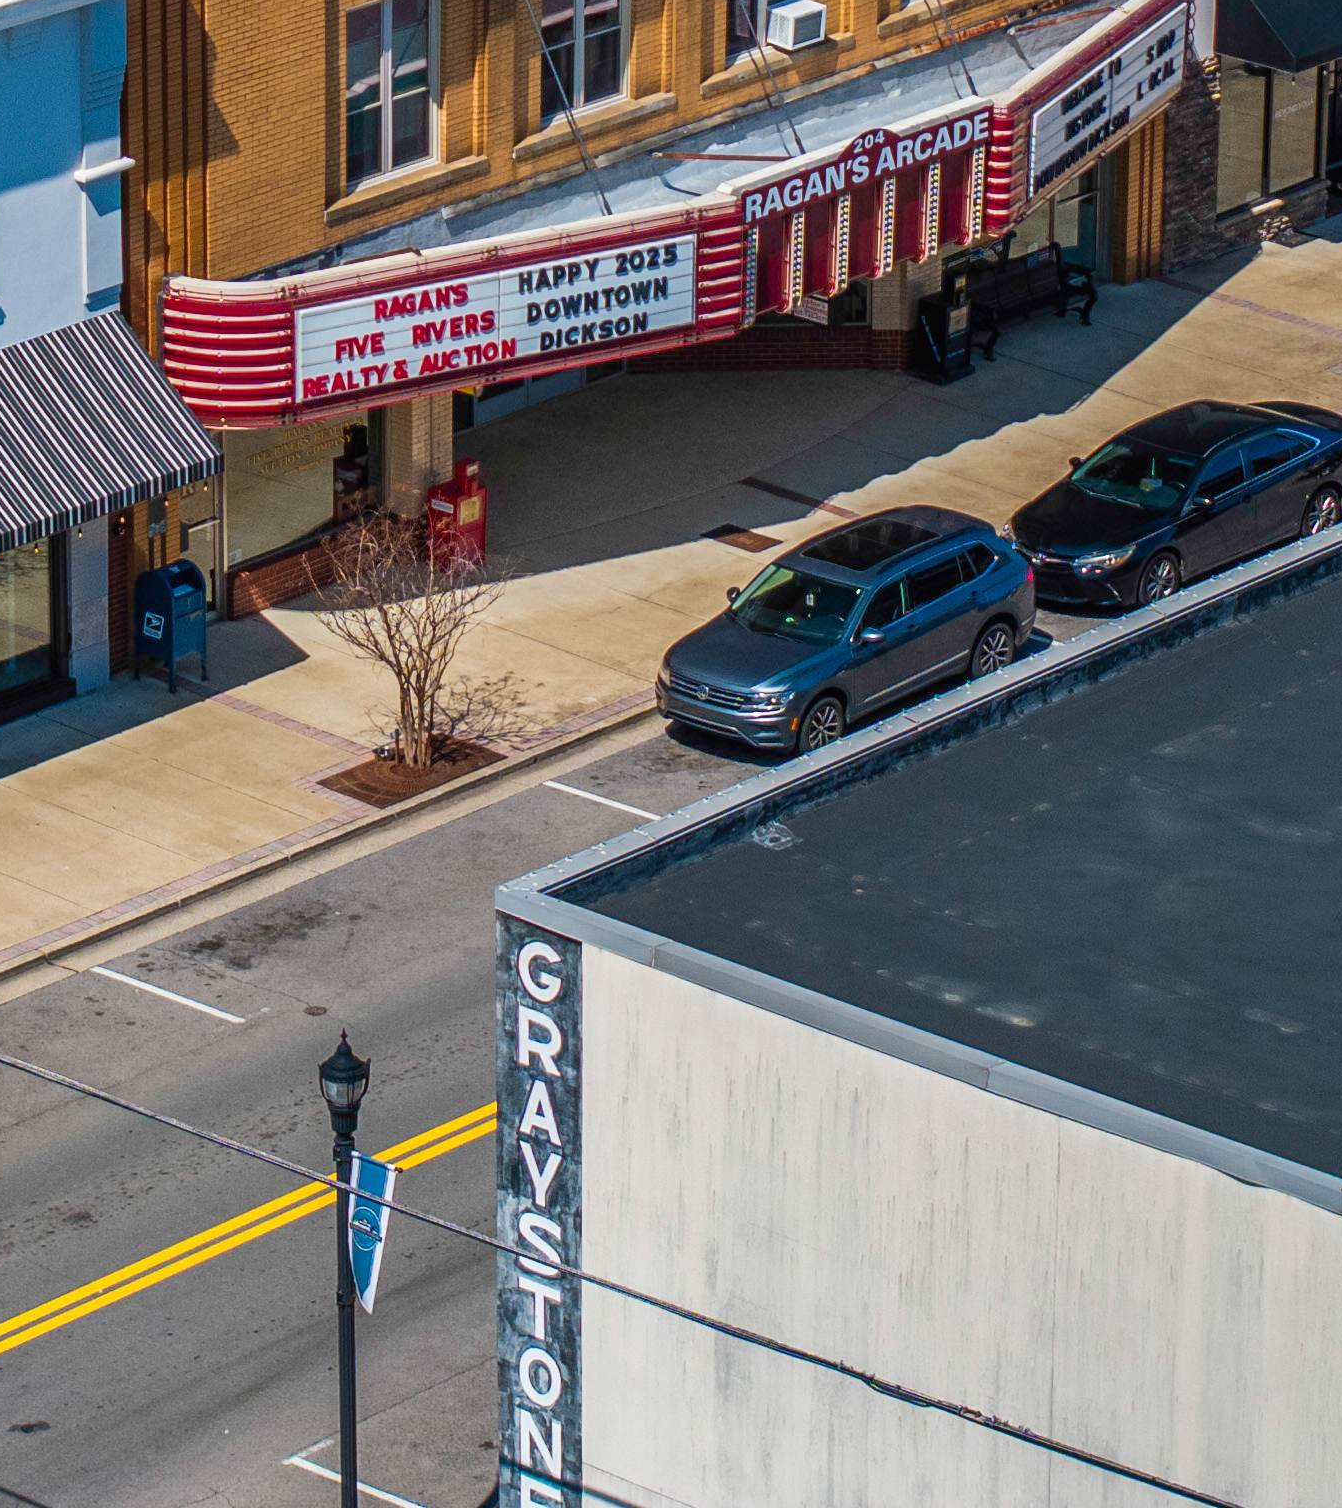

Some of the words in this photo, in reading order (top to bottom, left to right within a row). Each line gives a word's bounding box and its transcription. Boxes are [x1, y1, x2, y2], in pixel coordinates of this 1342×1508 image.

[744, 154, 870, 222] RAGAN'S
[875, 113, 989, 182] ARCADE
[853, 130, 886, 154] 204
[518, 257, 600, 295] HAPPY
[615, 243, 679, 274] 2025
[374, 283, 469, 322] RAGAN'S
[527, 277, 669, 325] DOWNTOWN
[335, 332, 385, 361] FIVE
[412, 310, 496, 346] RIVERS
[540, 312, 648, 353] DICKSON
[302, 363, 388, 399] REALTY
[393, 359, 409, 381] &
[420, 338, 517, 376] AUCTION
[516, 940, 564, 1508] GRAYSTON
